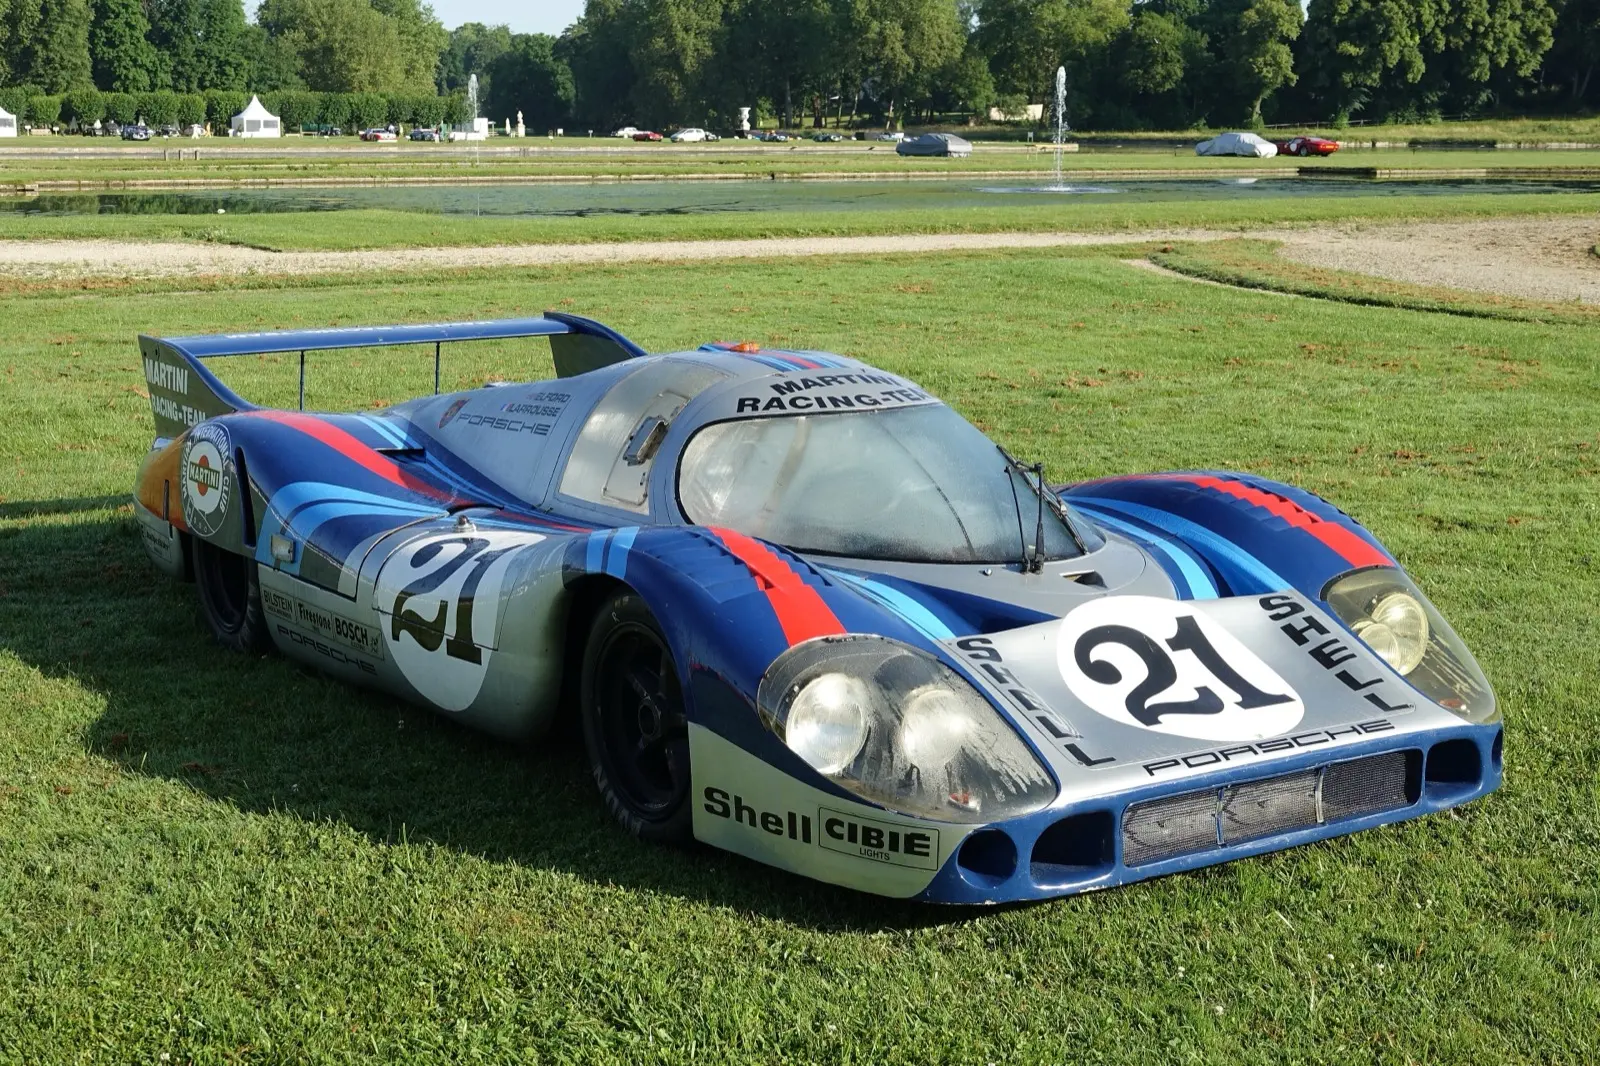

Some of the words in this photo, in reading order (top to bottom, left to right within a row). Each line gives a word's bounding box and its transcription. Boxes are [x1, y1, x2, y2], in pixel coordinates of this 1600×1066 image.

[145, 357, 188, 395] MARTINI
[770, 372, 903, 396] MARTINI
[457, 413, 551, 436] PORSCHE
[190, 463, 219, 488] MARTINI
[219, 475, 230, 514] CLUB
[298, 603, 331, 631] Firestone
[391, 537, 527, 665] 21
[277, 624, 378, 676] PORSCHE
[335, 617, 369, 646] BOSCH
[1074, 615, 1297, 727] 21
[1258, 594, 1411, 712] SHELL
[1143, 718, 1394, 776] PORSCHE
[703, 786, 812, 844] Shell
[859, 847, 890, 861] LIGHTS
